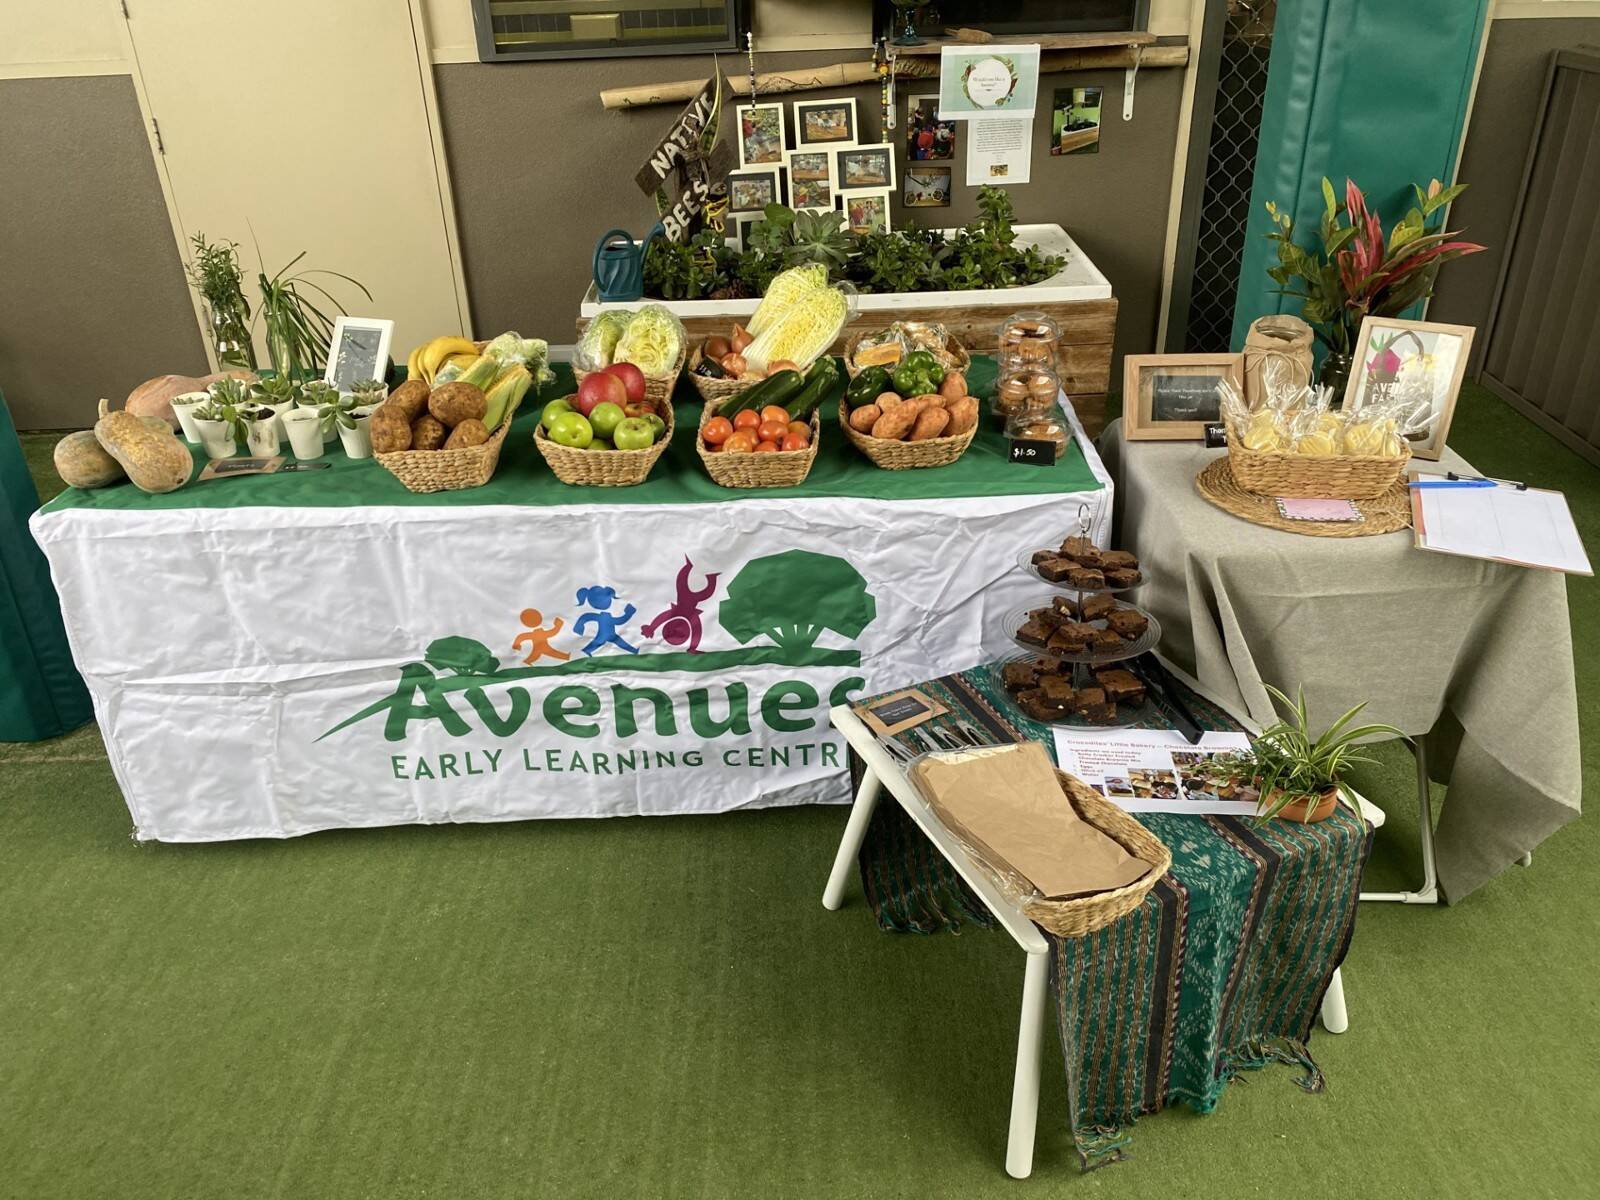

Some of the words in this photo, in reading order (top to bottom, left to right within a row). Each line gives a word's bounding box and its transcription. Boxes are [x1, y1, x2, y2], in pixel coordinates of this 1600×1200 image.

[662, 180, 709, 242] BEES
[1209, 427, 1227, 435] Than
[1013, 447, 1037, 458] $1.50
[391, 748, 503, 780] EARLY
[523, 747, 704, 775] LEARNING
[723, 741, 850, 769] CENTR
